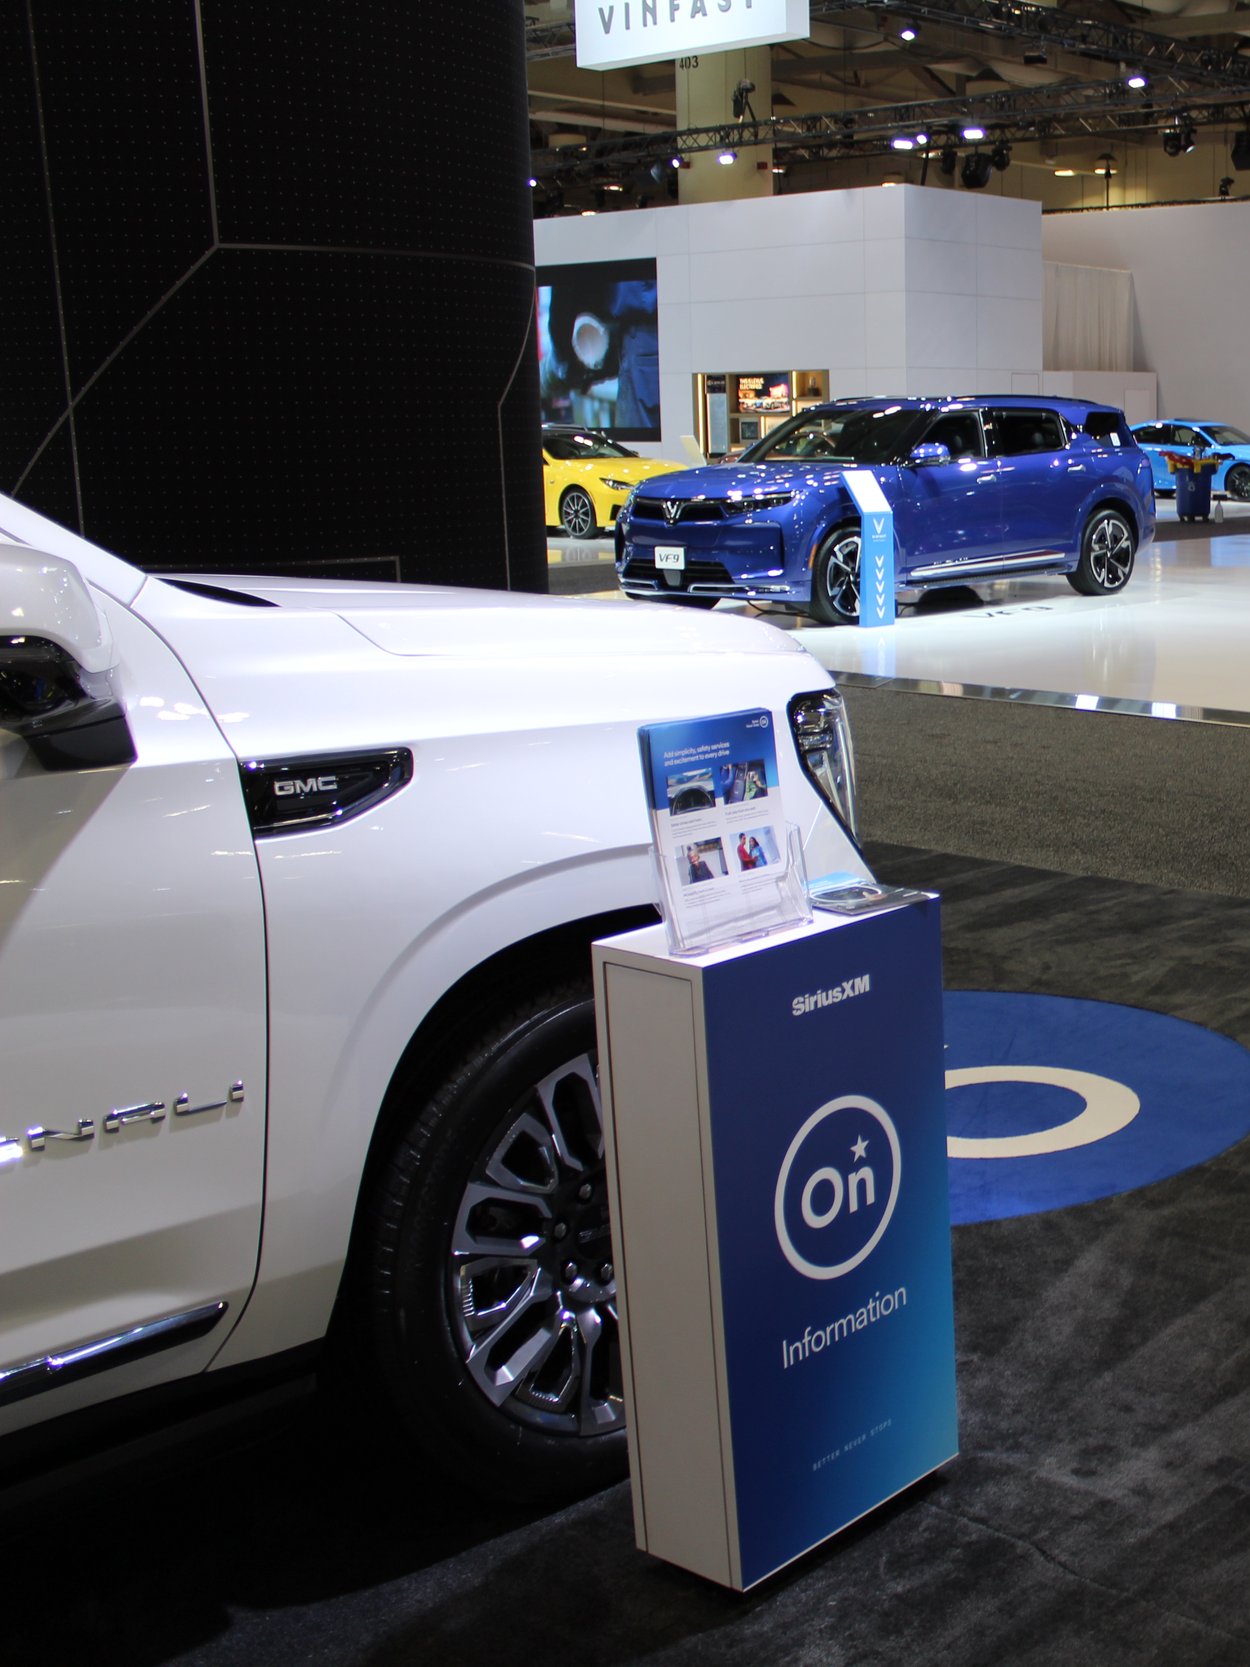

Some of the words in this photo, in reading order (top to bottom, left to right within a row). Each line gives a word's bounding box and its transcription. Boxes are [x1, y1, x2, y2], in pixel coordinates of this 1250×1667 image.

[679, 56, 699, 69] 403
[658, 552, 680, 563] VF9
[274, 776, 338, 796] GMC
[792, 974, 870, 1016] SiriusXM
[801, 1166, 875, 1229] On
[782, 1287, 907, 1369] Information
[813, 1449, 840, 1472] BETTER
